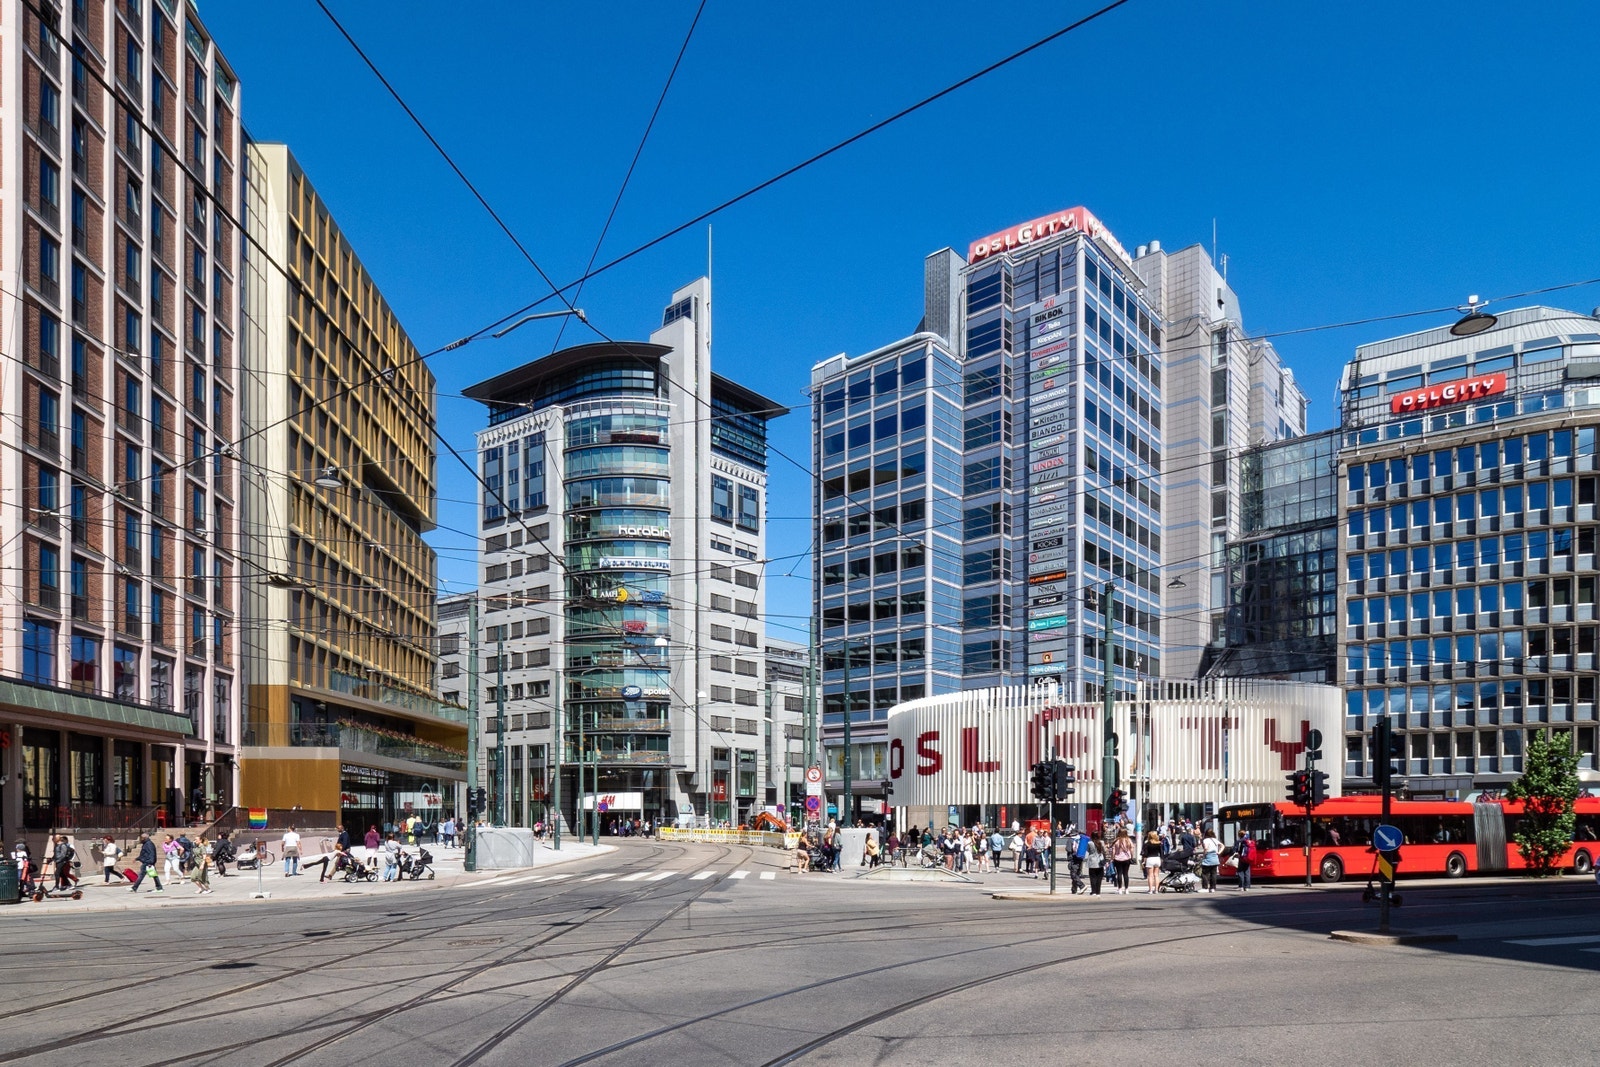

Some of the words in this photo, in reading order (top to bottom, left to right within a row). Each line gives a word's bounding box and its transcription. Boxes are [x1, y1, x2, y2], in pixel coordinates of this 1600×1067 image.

[1035, 313, 1047, 323] BIK
[1047, 307, 1063, 319] BOK
[1031, 394, 1048, 403] VERO
[1048, 388, 1067, 398] MODA
[1032, 457, 1064, 472] LINDEX
[618, 525, 671, 538] karabin
[1037, 538, 1058, 548] KICKS
[627, 560, 642, 568] THON
[643, 561, 669, 569] GRUPPEN
[643, 687, 671, 696] apotek
[342, 764, 359, 774] CLARION
